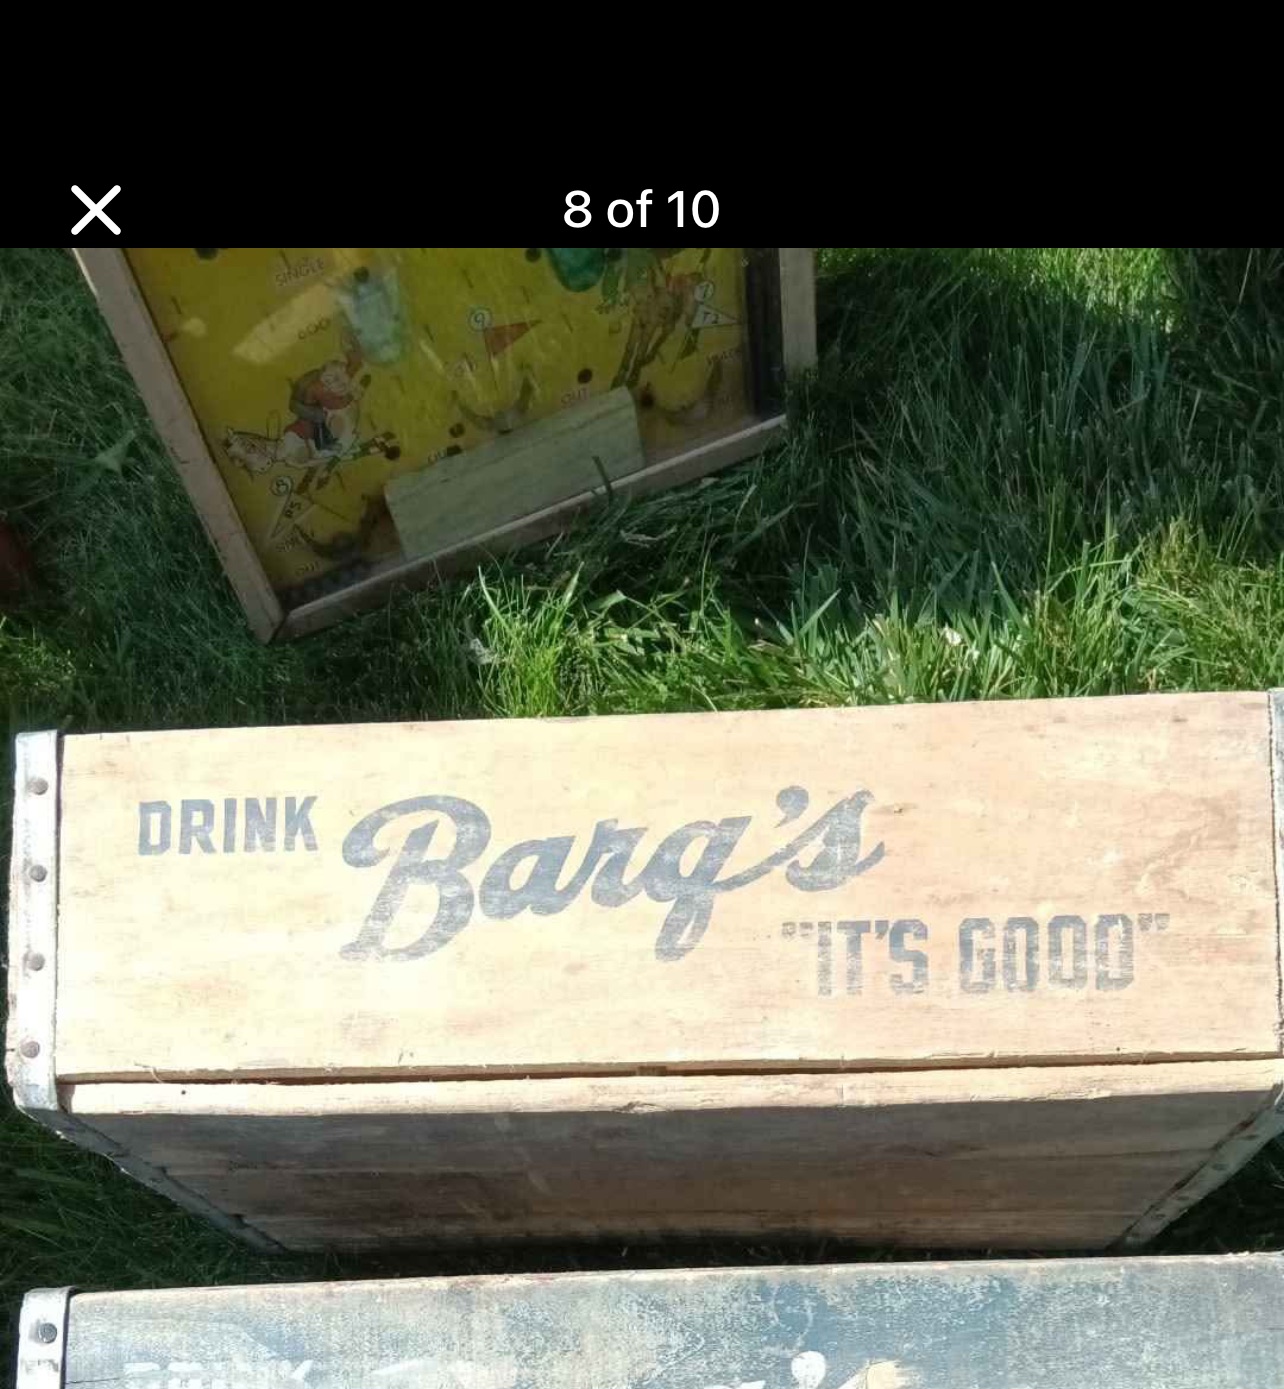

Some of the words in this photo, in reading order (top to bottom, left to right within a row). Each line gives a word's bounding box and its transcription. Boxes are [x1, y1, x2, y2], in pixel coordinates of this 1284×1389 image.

[137, 795, 319, 857] DRINK
[338, 784, 887, 964] Barq's
[957, 912, 1172, 995] GOOD"
